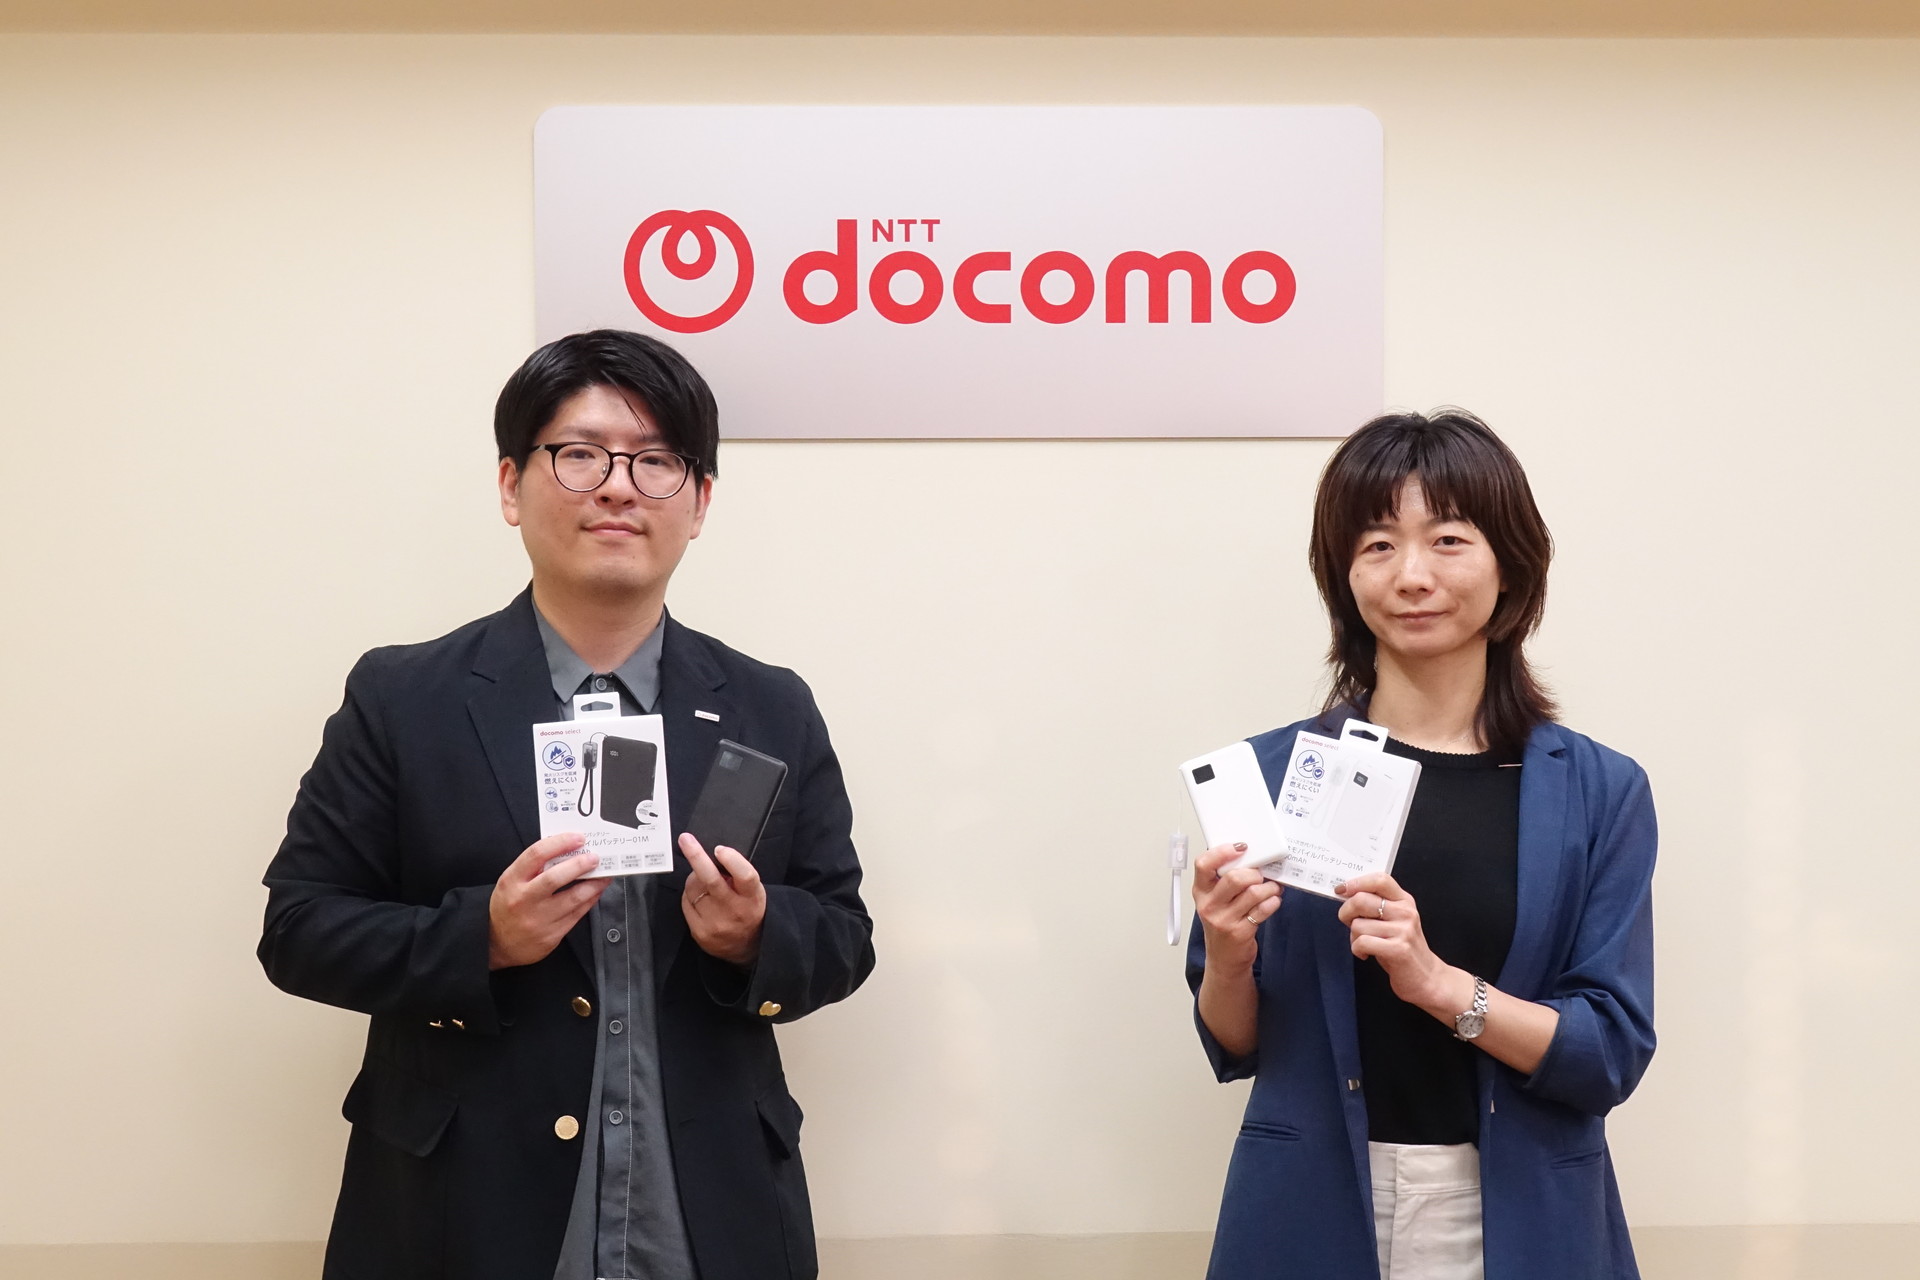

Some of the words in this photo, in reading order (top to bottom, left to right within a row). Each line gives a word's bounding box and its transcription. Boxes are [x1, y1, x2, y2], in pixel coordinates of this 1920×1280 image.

[872, 219, 940, 242] NTT
[783, 219, 1296, 324] docomo
[1301, 737, 1323, 747] docomo
[544, 776, 578, 785] 燃えにくい
[1289, 780, 1320, 794] 燃えにくい
[1284, 853, 1307, 865] 0mAh
